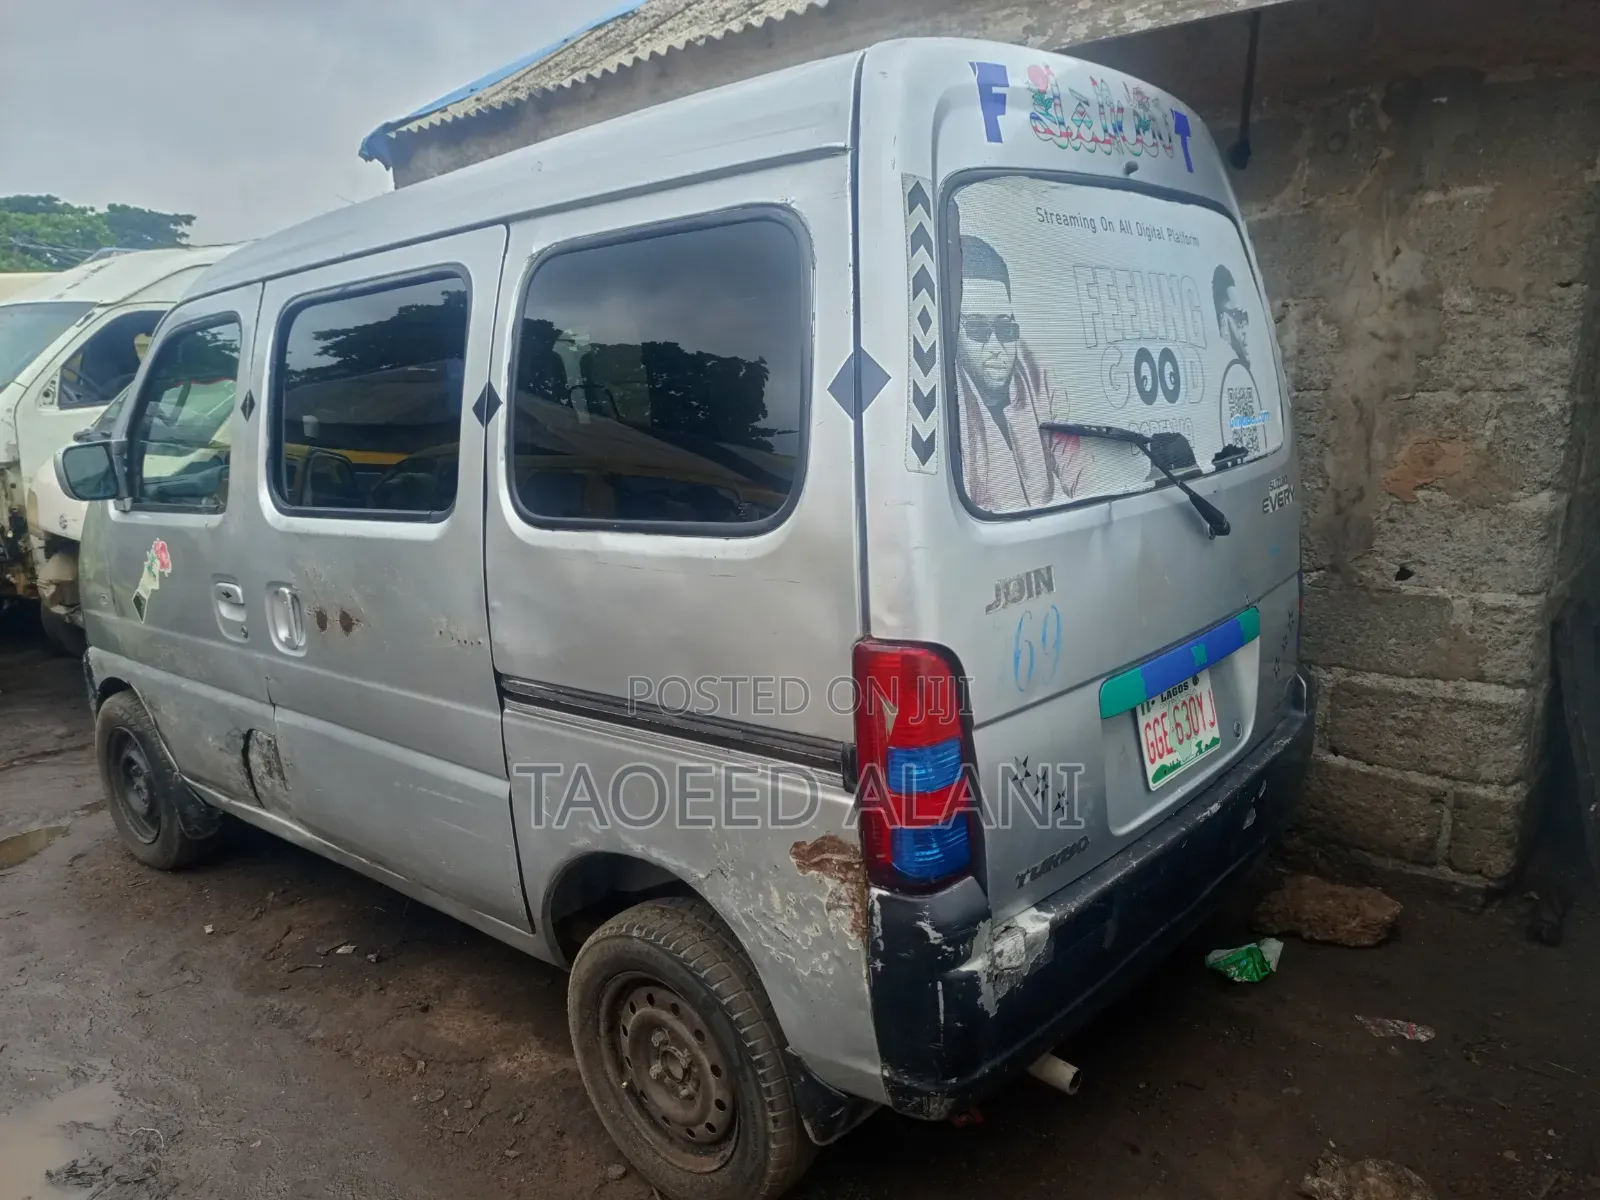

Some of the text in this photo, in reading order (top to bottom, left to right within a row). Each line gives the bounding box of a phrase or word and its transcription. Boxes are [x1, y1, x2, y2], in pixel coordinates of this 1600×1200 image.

[1035, 206, 1200, 248] Streaming On All Digital Platform
[1073, 264, 1207, 349] FEELING
[1262, 485, 1296, 515] EVERY
[985, 564, 1056, 615] JOIN
[1013, 604, 1062, 692] 69
[1160, 681, 1190, 702] LAGOS
